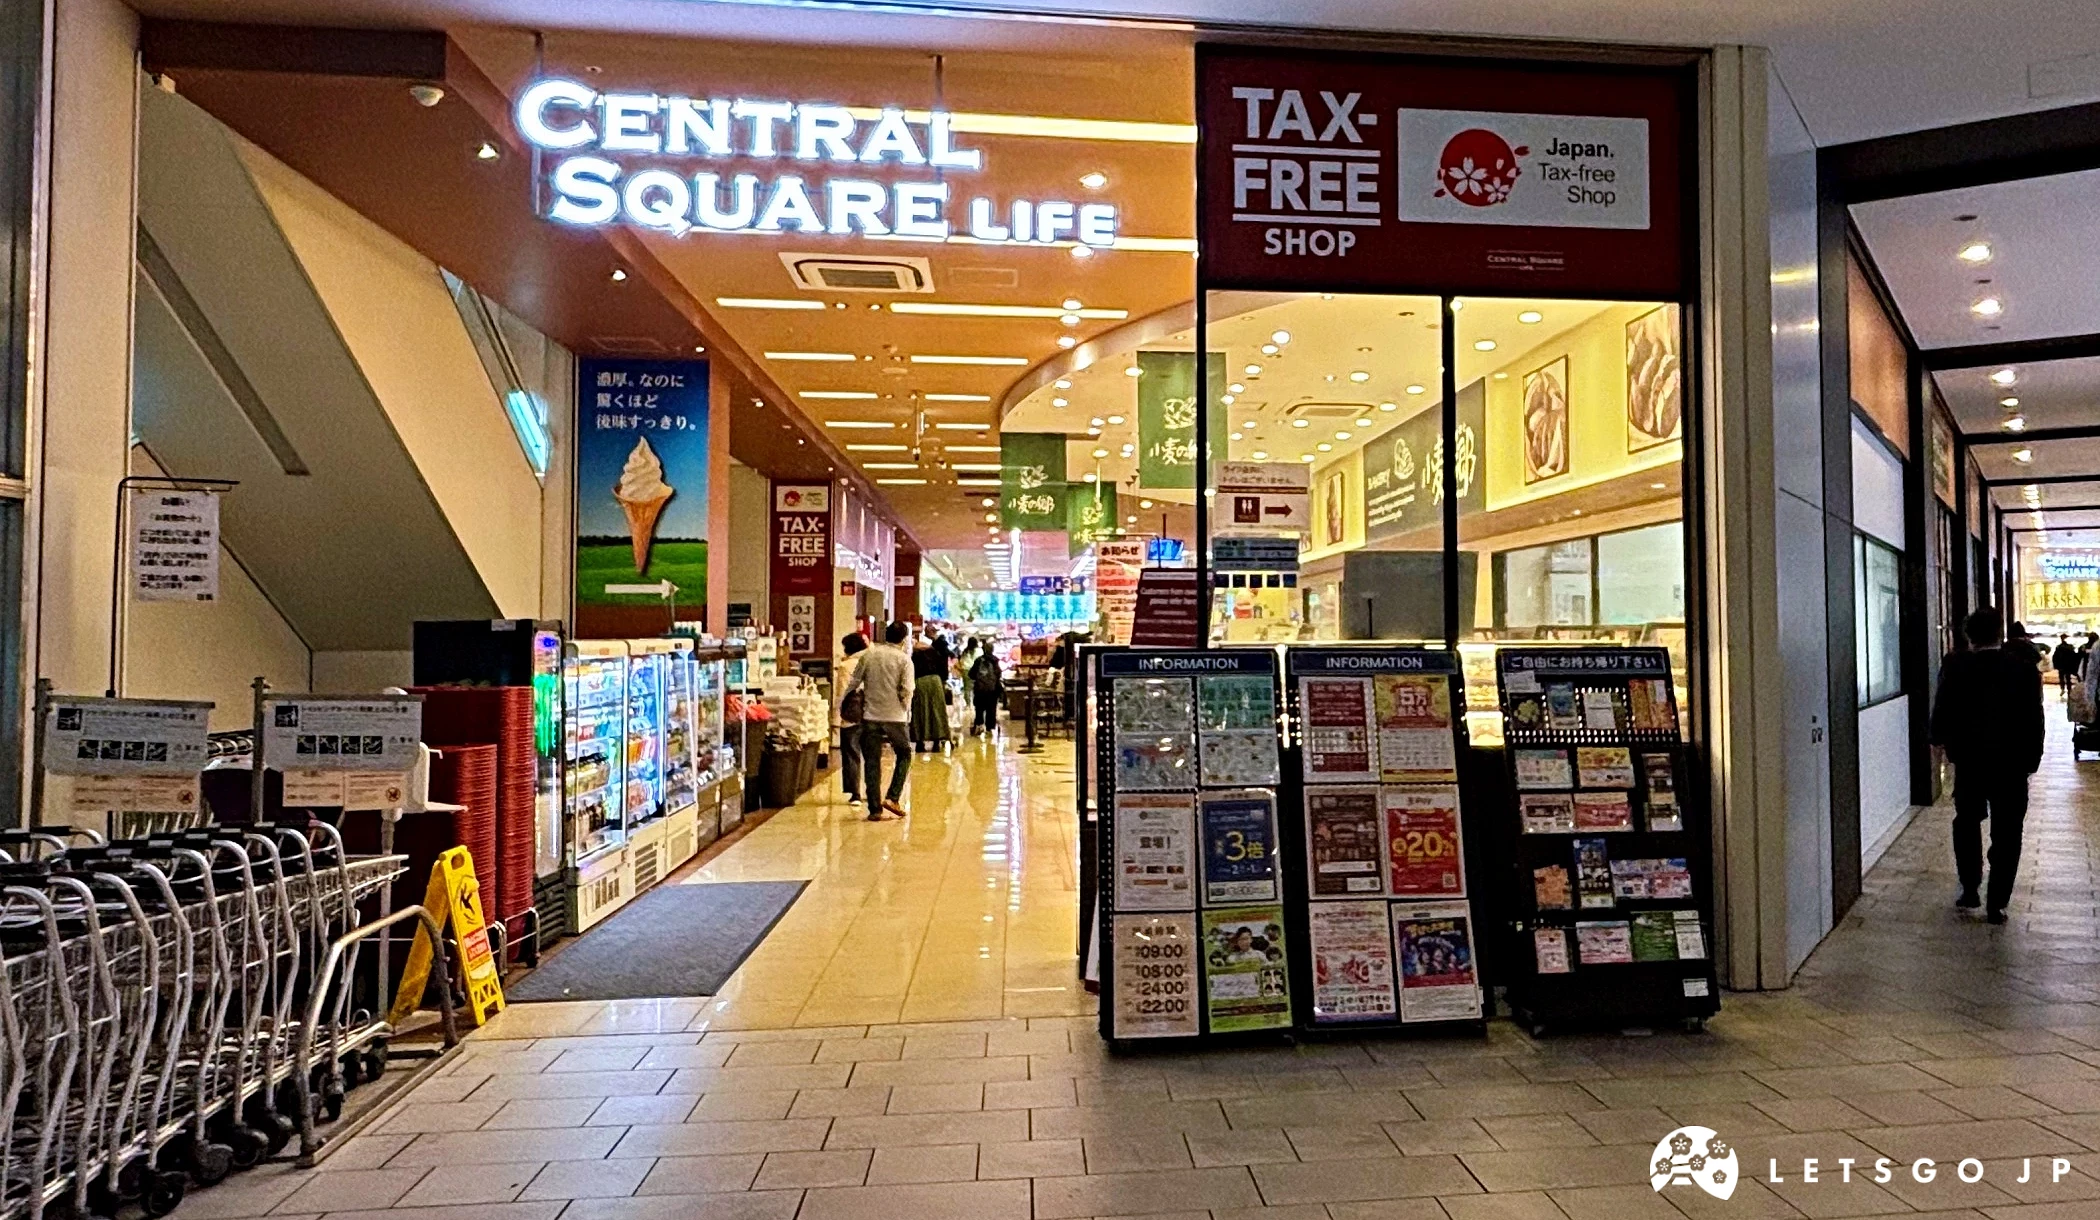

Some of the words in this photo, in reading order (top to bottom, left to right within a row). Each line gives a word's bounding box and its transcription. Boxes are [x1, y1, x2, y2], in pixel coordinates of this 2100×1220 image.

[517, 79, 983, 170] CENTRAL
[1232, 87, 1377, 143] TAX-
[1546, 137, 1614, 160] Japan.
[1538, 162, 1616, 183] Tax-free
[1233, 157, 1380, 213] FREE
[551, 156, 948, 243] SQUARE
[970, 197, 1117, 246] LIFE
[1567, 185, 1616, 207] Shop
[1264, 228, 1356, 257] SHOP
[779, 516, 825, 533] TAX-
[779, 537, 825, 553] FREE
[788, 557, 818, 567] SHOP
[1138, 657, 1239, 670] INFORMATION
[1326, 656, 1423, 669] INFORMATION
[1511, 656, 1657, 669] ご自由にお持ち帰り下さい
